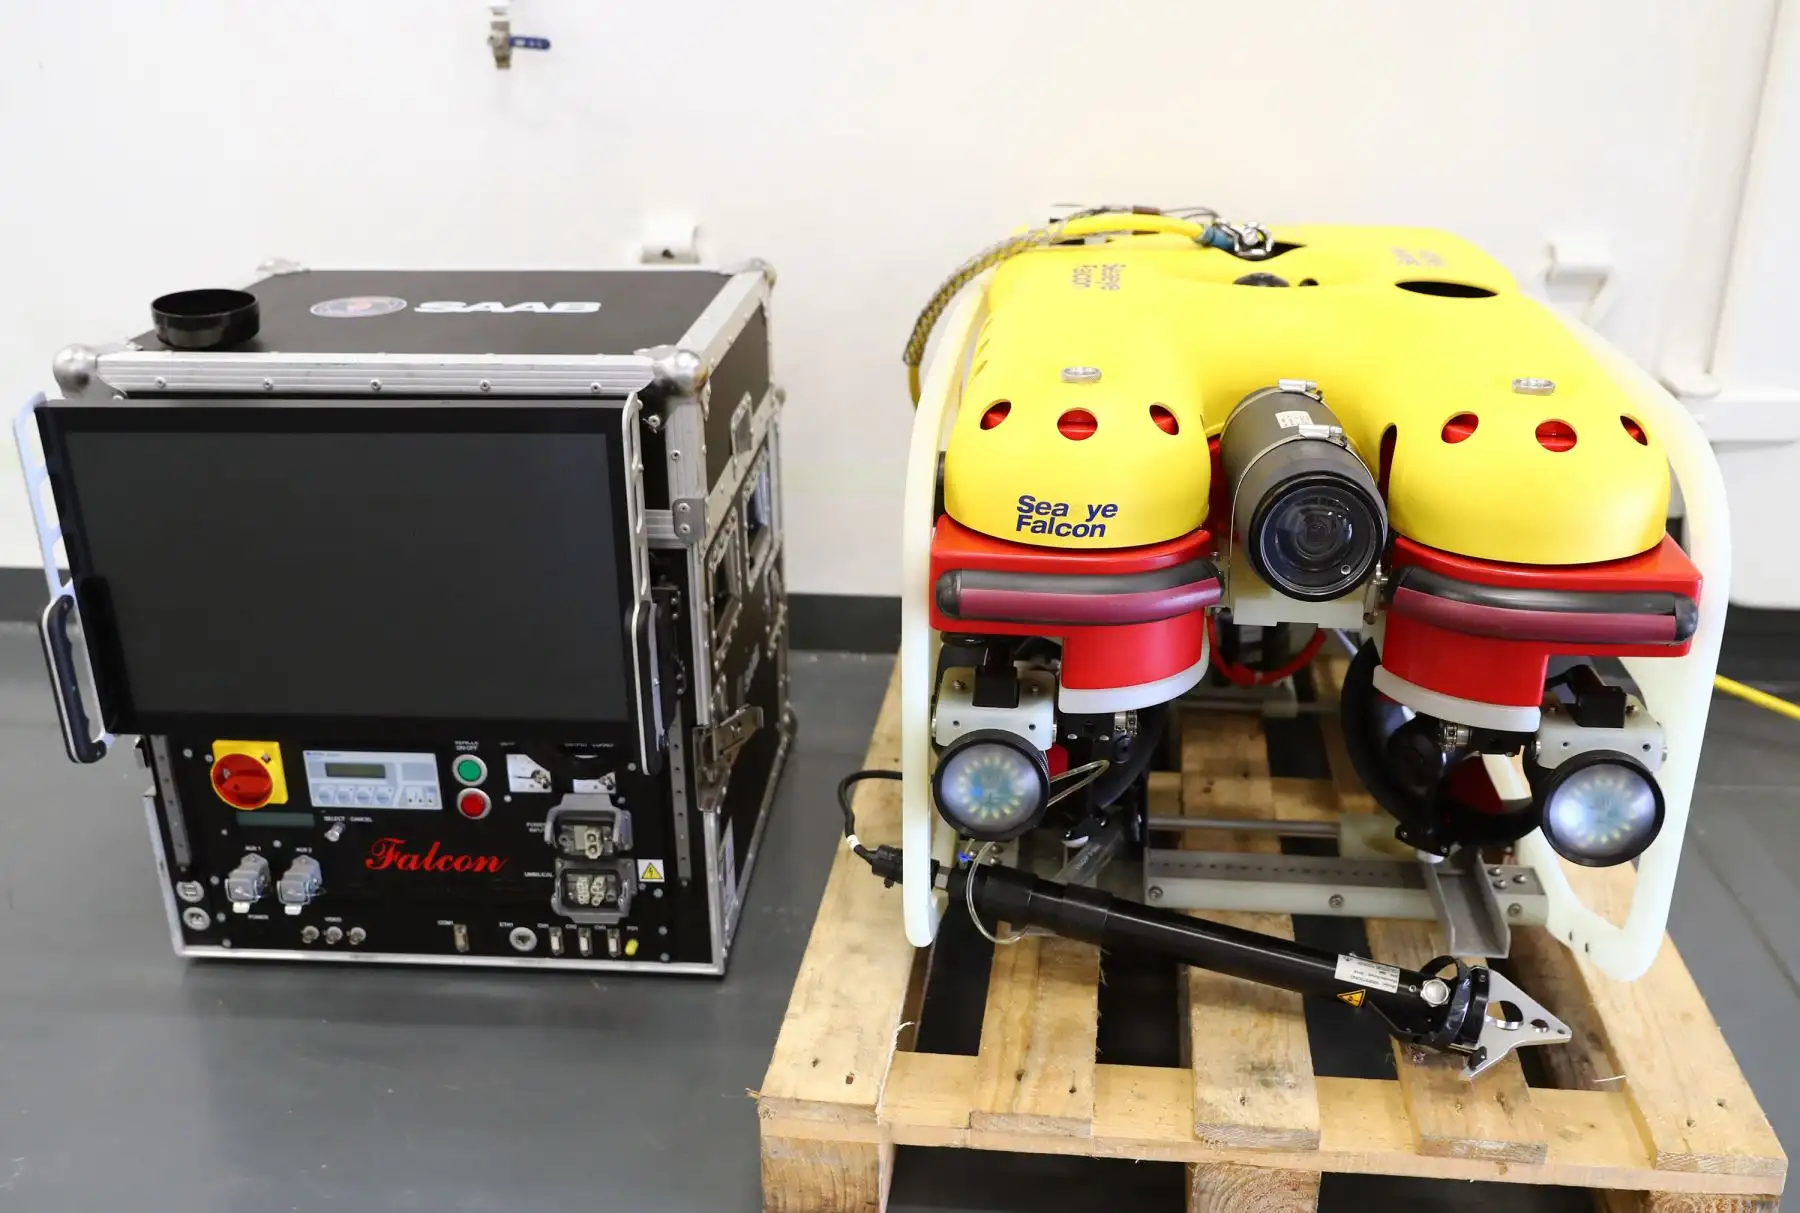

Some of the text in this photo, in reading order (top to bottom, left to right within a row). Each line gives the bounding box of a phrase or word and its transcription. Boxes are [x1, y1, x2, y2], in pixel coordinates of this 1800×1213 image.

[414, 301, 602, 313] SAAB
[1015, 514, 1106, 538] Falcon
[365, 837, 507, 872] Falcon
